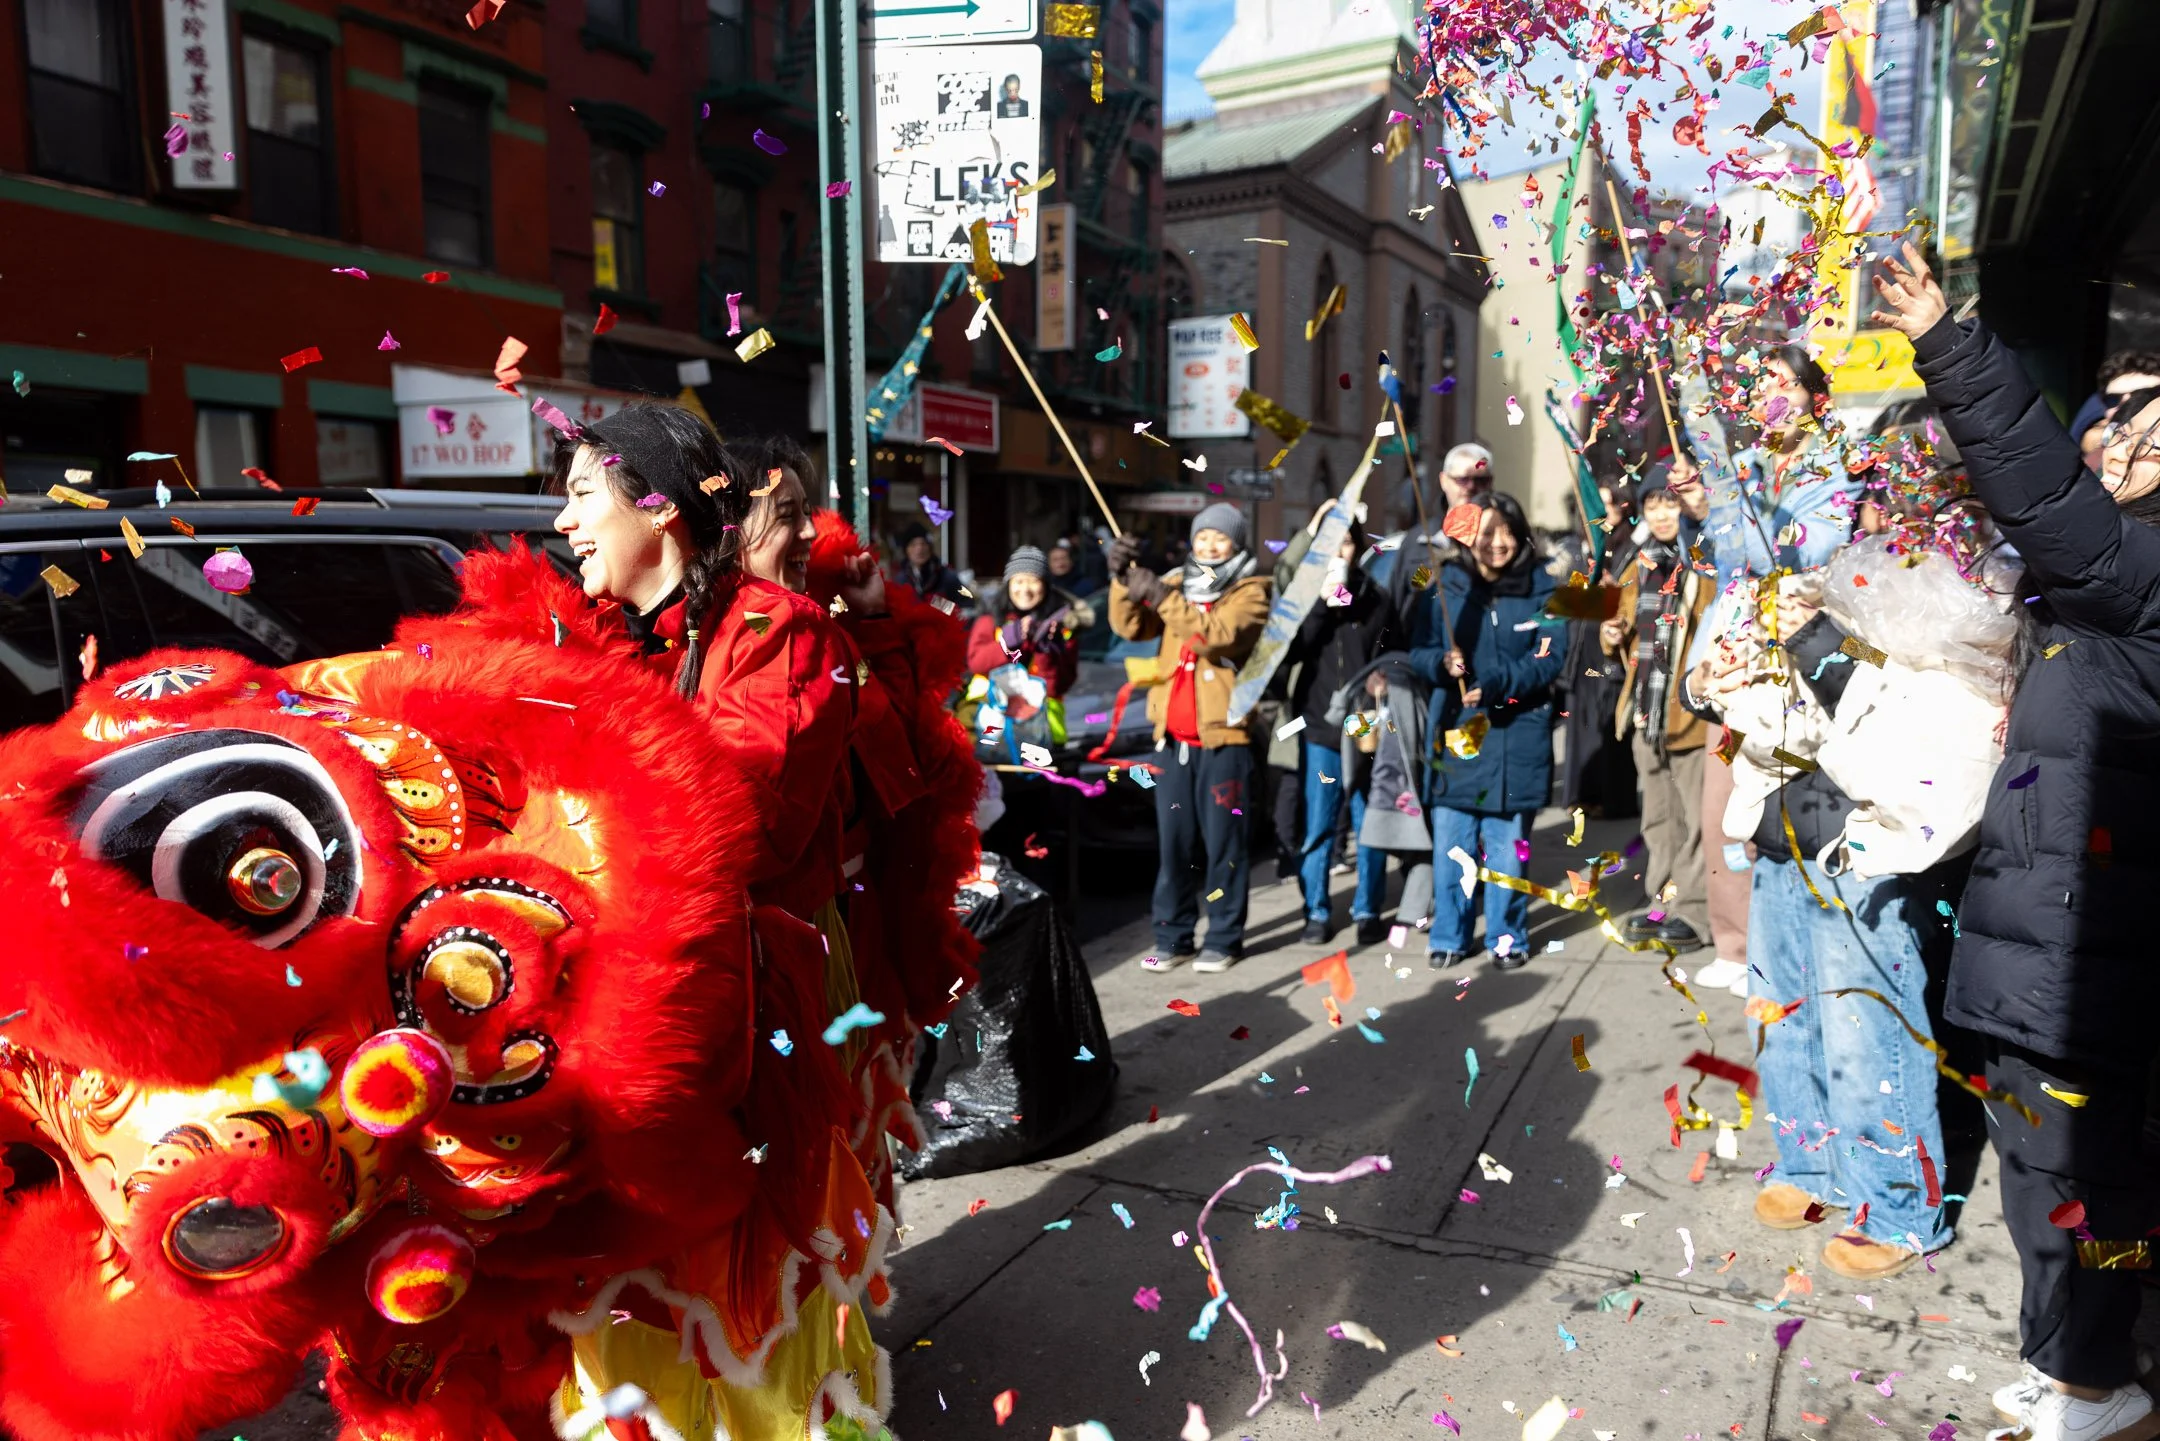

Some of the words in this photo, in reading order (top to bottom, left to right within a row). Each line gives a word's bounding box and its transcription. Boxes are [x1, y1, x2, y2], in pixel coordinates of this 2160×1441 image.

[884, 82, 896, 94] N
[880, 94, 900, 106] DIE
[411, 443, 431, 465] 17
[435, 443, 468, 465] WO
[472, 442, 515, 465] HOP
